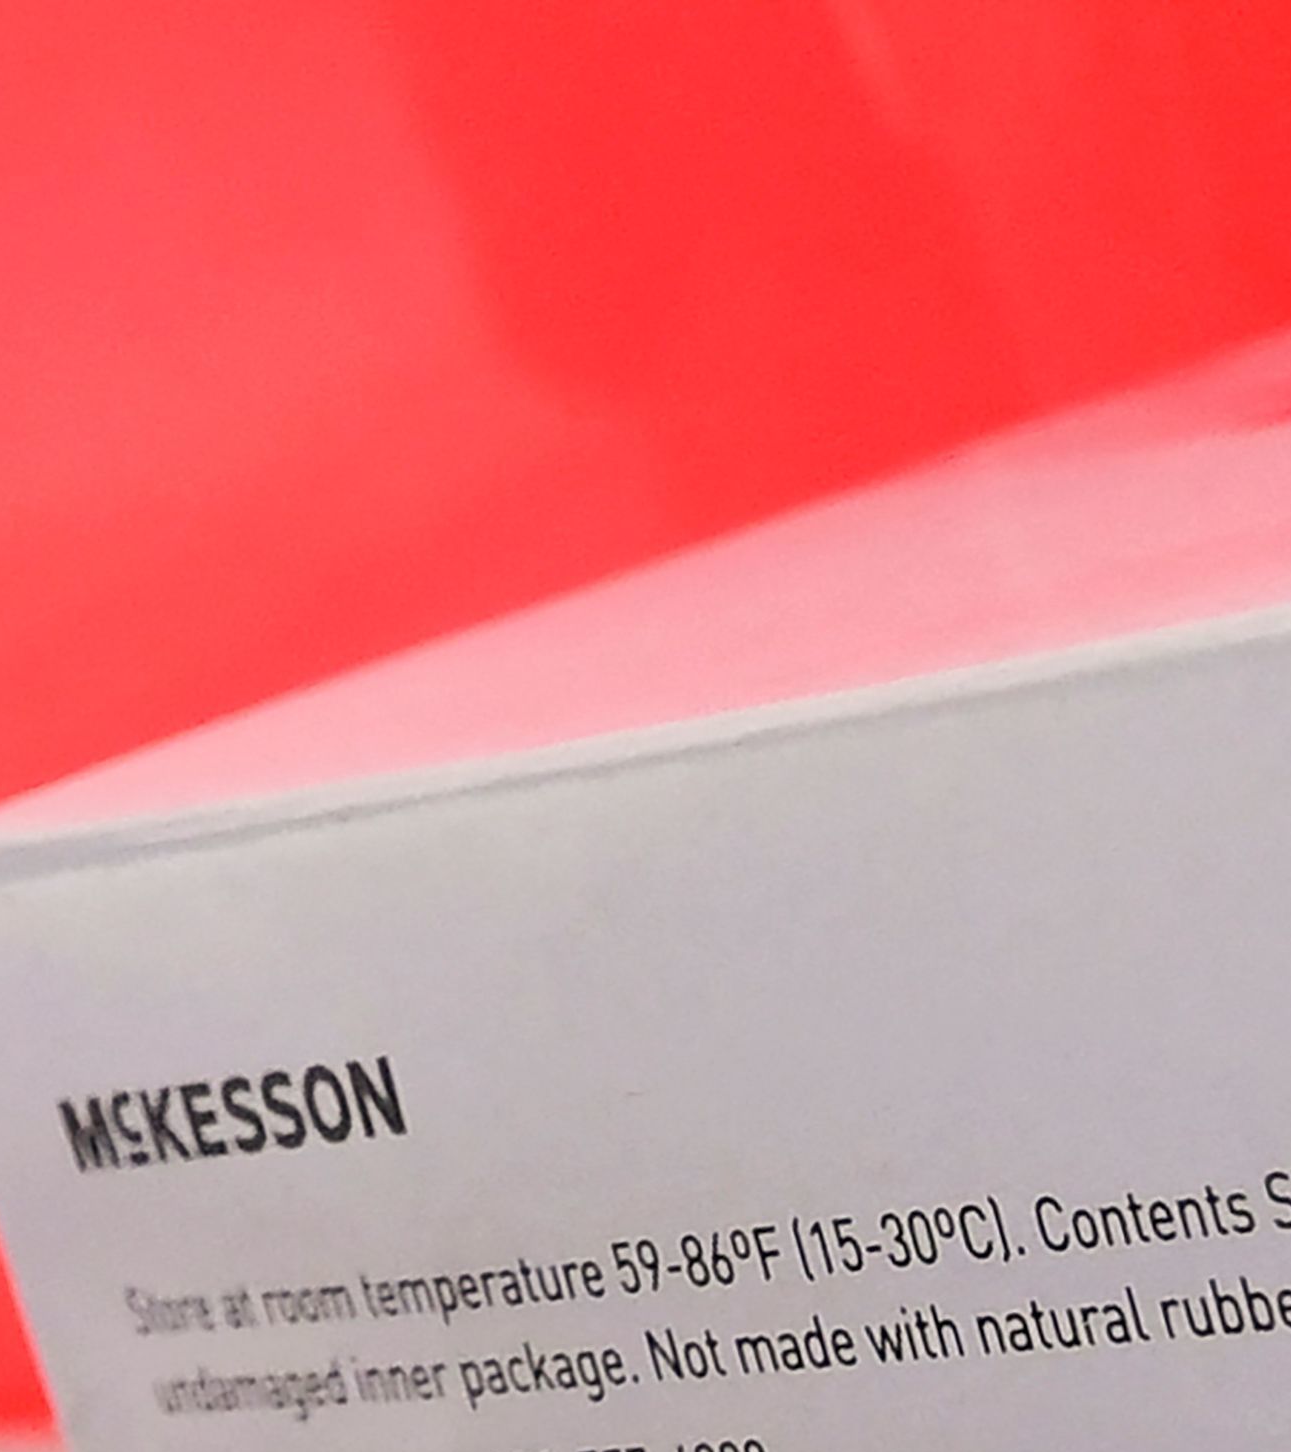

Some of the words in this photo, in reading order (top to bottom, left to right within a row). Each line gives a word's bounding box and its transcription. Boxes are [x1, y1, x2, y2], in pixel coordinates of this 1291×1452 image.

[124, 1287, 218, 1337] Store
[221, 1292, 258, 1331] at
[262, 1284, 357, 1328] room
[362, 1257, 606, 1326] temperature
[1034, 1183, 1257, 1254] Contents
[159, 1366, 349, 1421] undamaged
[353, 1355, 447, 1399] inner
[459, 1340, 640, 1408] package.
[644, 1327, 727, 1383] Not
[735, 1314, 859, 1376] made
[866, 1302, 966, 1364] with
[975, 1285, 1151, 1355] natural
